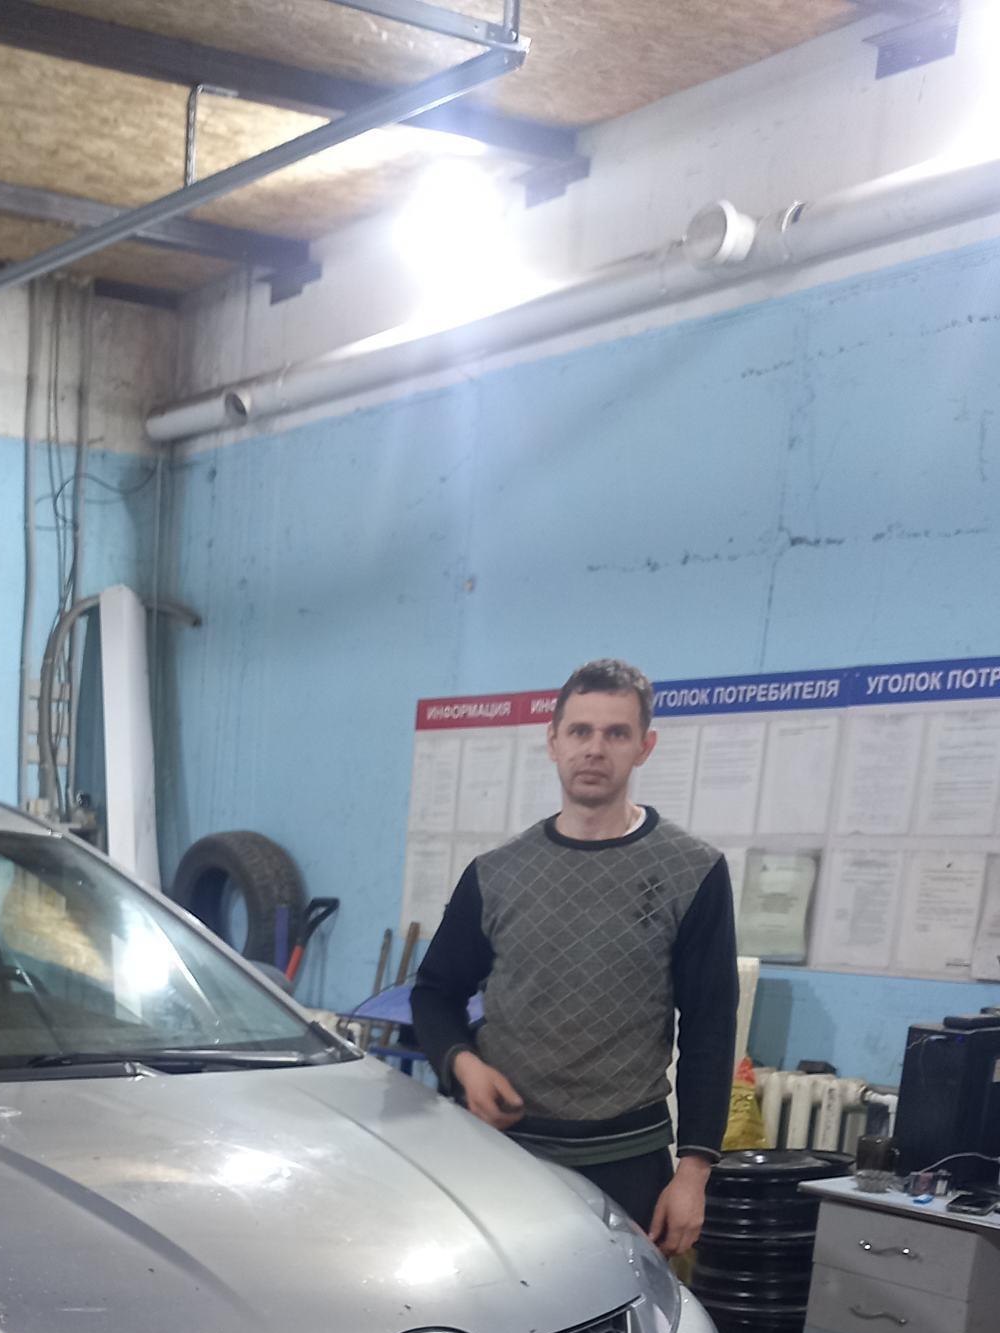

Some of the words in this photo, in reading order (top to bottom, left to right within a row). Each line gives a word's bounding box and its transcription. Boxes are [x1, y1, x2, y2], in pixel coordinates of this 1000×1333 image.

[713, 679, 840, 704] ПОТРЕБИТЕЛЯ
[866, 672, 944, 695] УГОЛОК
[427, 701, 512, 720] ИНФОРМАЦИЯ
